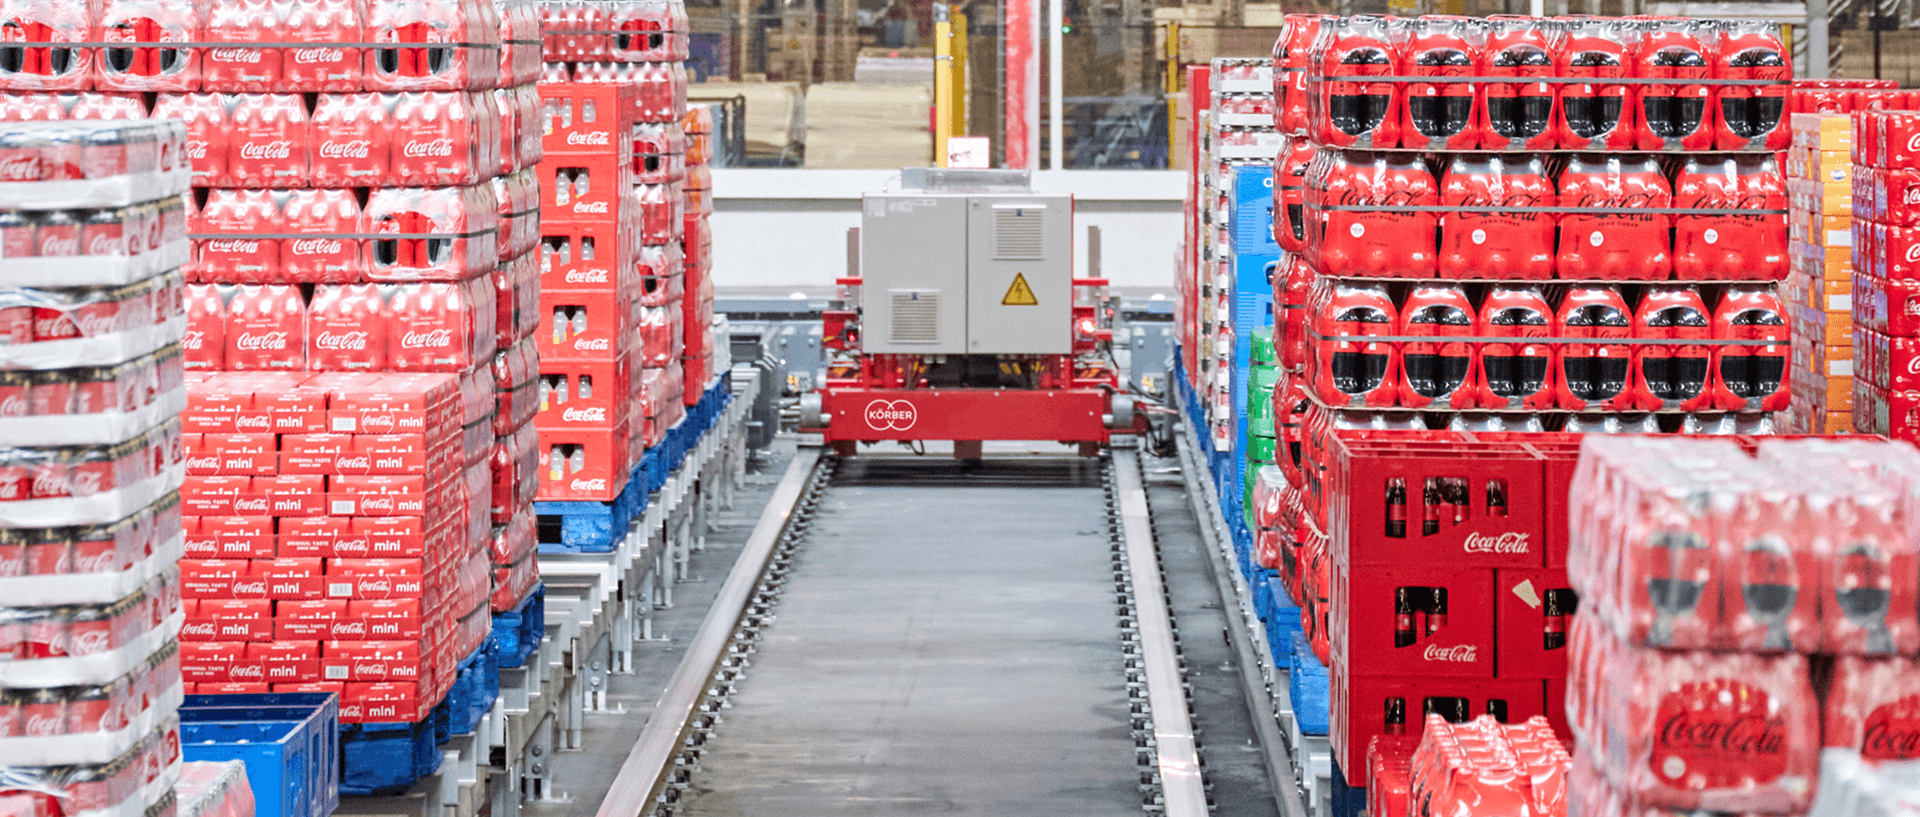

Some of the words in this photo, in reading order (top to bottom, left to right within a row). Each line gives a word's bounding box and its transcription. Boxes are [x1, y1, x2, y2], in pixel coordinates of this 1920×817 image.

[566, 131, 609, 145] Coca-Cola
[241, 140, 292, 159] Coca-Cola
[320, 140, 372, 158] Coca-Cola
[404, 138, 454, 157] Coca-Cola
[574, 202, 608, 214] Coca-Cola
[565, 270, 608, 283] Coca-Cola
[237, 331, 288, 350] Coca-Cola
[316, 331, 369, 350] Coca-Cola
[402, 329, 452, 348] Coca-Cola
[574, 338, 609, 350] Coca-Cola
[563, 407, 606, 422] Coca-Cola
[870, 408, 912, 420] KÖRBER
[237, 416, 269, 427] Coca-Cola
[276, 416, 302, 427] mini
[362, 416, 392, 426] Coca-Cola
[399, 416, 422, 427] mini
[186, 457, 218, 468] Coca-Cola
[226, 458, 252, 468] mini
[336, 457, 369, 468] Coca-Cola
[376, 457, 402, 468] mini
[571, 478, 606, 490] Coca-Cola
[236, 498, 268, 510] Coca-Cola
[275, 499, 301, 510] mini
[362, 498, 392, 510] Coca-Cola
[398, 500, 422, 510] mini
[184, 540, 216, 552] Coca-Cola
[224, 540, 250, 552] mini
[335, 540, 366, 551] Coca-Cola
[374, 540, 400, 552] mini
[1464, 532, 1530, 553] Coca-Cola
[234, 581, 266, 594] Coca-Cola
[273, 582, 300, 593] mini
[360, 581, 390, 592] Coca-Cola
[396, 582, 420, 592] mini
[182, 624, 215, 635] Coca-Cola
[222, 624, 248, 635] mini
[332, 622, 365, 634] Coca-Cola
[372, 622, 398, 634] mini
[1424, 644, 1478, 662] Coca-Cola
[230, 666, 262, 677] Coca-Cola
[270, 666, 296, 676] mini
[356, 664, 386, 675] Coca-Cola
[392, 666, 416, 676] mini
[370, 705, 395, 716] mini
[1661, 711, 1783, 754] Coca-Cola
